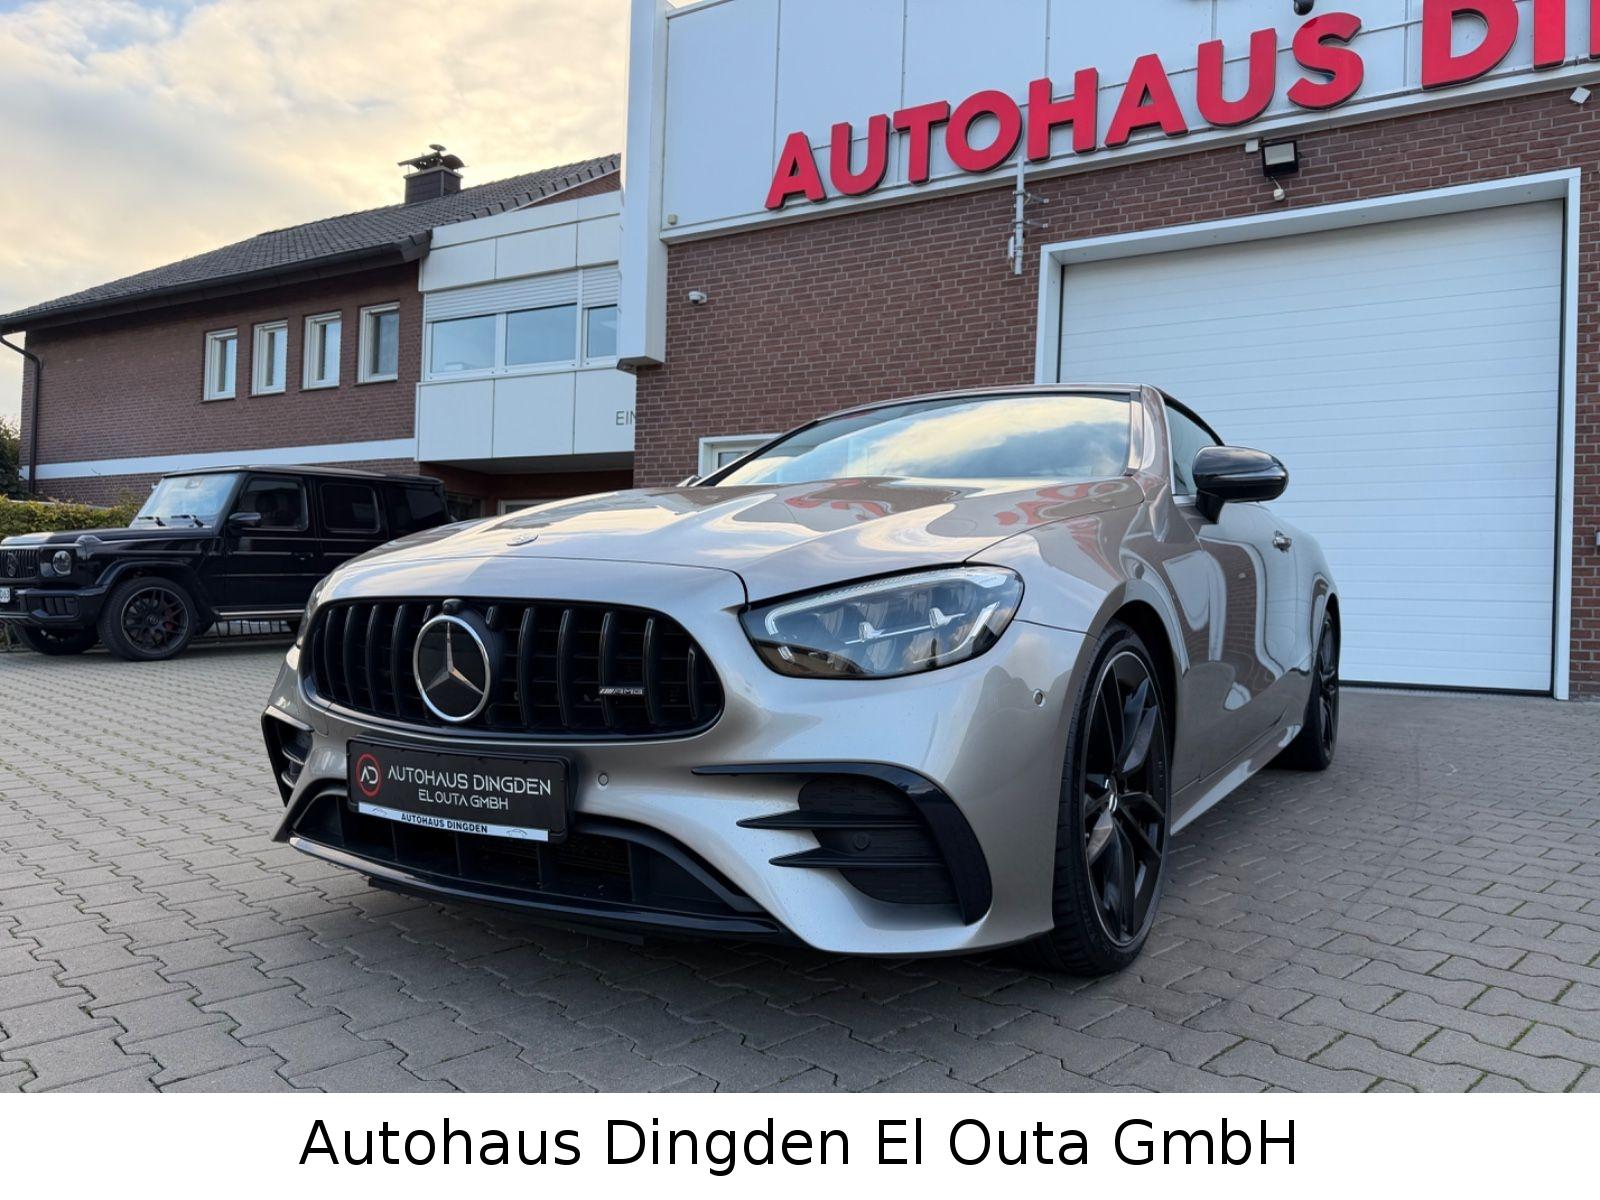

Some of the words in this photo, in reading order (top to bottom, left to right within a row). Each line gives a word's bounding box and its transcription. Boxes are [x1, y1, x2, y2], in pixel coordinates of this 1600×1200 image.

[765, 12, 1364, 210] AUTOHAUS
[1421, 0, 1600, 90] DI
[387, 764, 469, 790] AUTOHAUS
[473, 774, 551, 796] DINGDEN
[418, 788, 434, 803] EL
[435, 791, 469, 807] OUTA
[470, 795, 509, 810] GMBH
[400, 812, 445, 828] AUTOHAUS
[446, 819, 488, 834] DINGDEN
